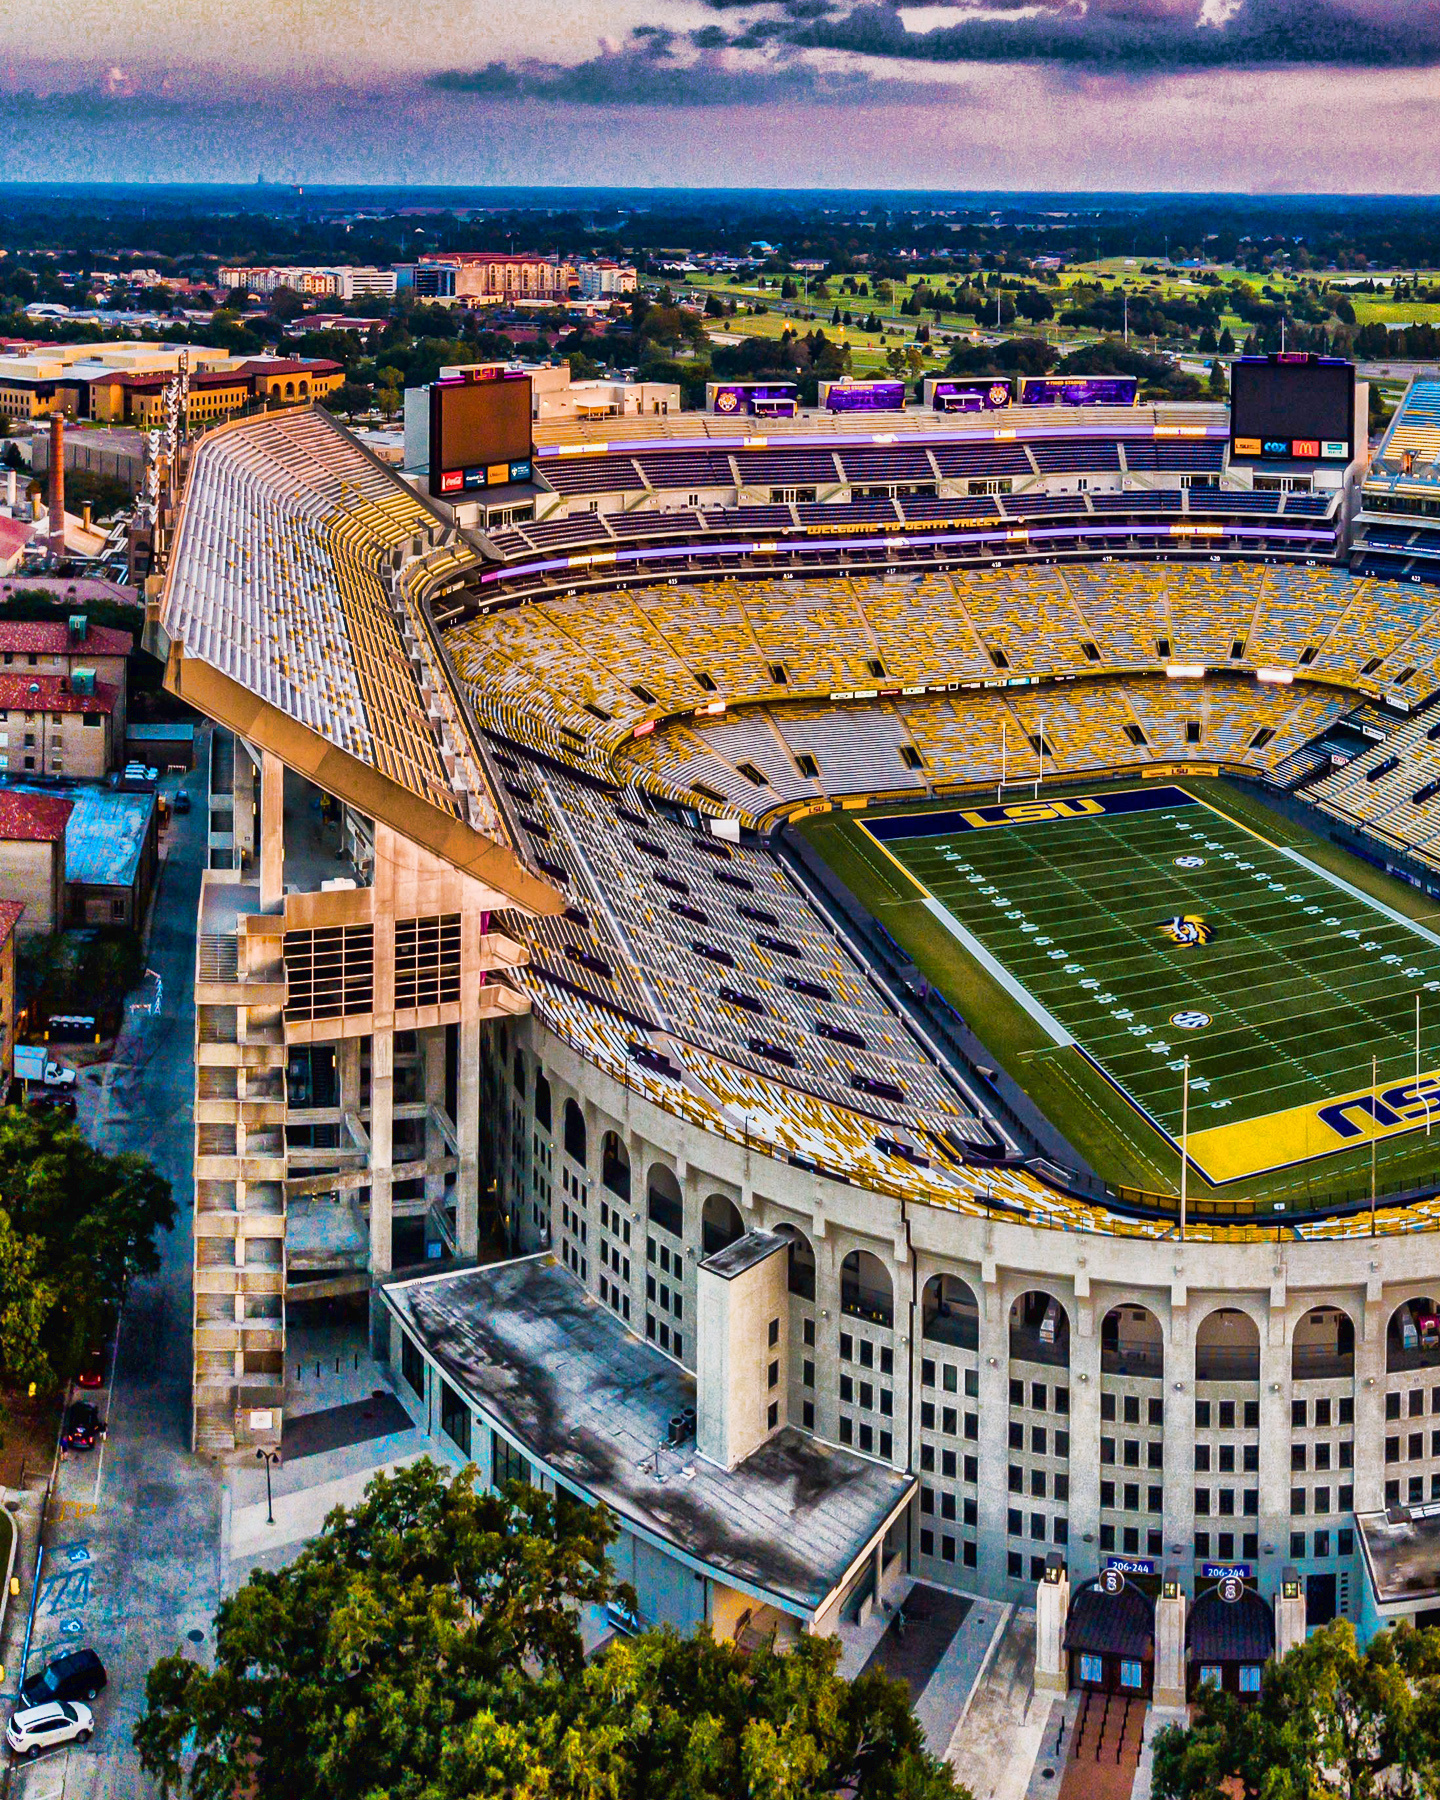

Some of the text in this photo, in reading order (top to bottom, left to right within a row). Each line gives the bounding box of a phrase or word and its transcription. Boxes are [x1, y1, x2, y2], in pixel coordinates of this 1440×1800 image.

[807, 516, 1001, 535] WELCOME TO DEATH VALLEY
[808, 805, 825, 814] LSU
[959, 799, 1106, 828] LSU
[1004, 910, 1026, 920] 35
[1303, 905, 1324, 915] 50
[1320, 917, 1341, 926] 45
[1019, 923, 1039, 932] 40
[1340, 929, 1361, 938] 40
[1033, 936, 1054, 946] 45
[1359, 941, 1383, 951] 35
[1047, 949, 1069, 959] 50
[1380, 954, 1403, 964] 30
[1063, 963, 1085, 974] 45
[1401, 967, 1425, 978] 25
[1079, 978, 1100, 989] 40
[1093, 992, 1117, 1004] 35
[1110, 1008, 1135, 1020] 30
[1127, 1024, 1153, 1036] 25
[1145, 1040, 1171, 1053] 20
[1166, 1059, 1191, 1071] 15
[1187, 1077, 1211, 1089] 10
[1211, 1100, 1232, 1109] 5
[1112, 1561, 1149, 1573] 206-244
[1208, 1568, 1245, 1578] 206-244
